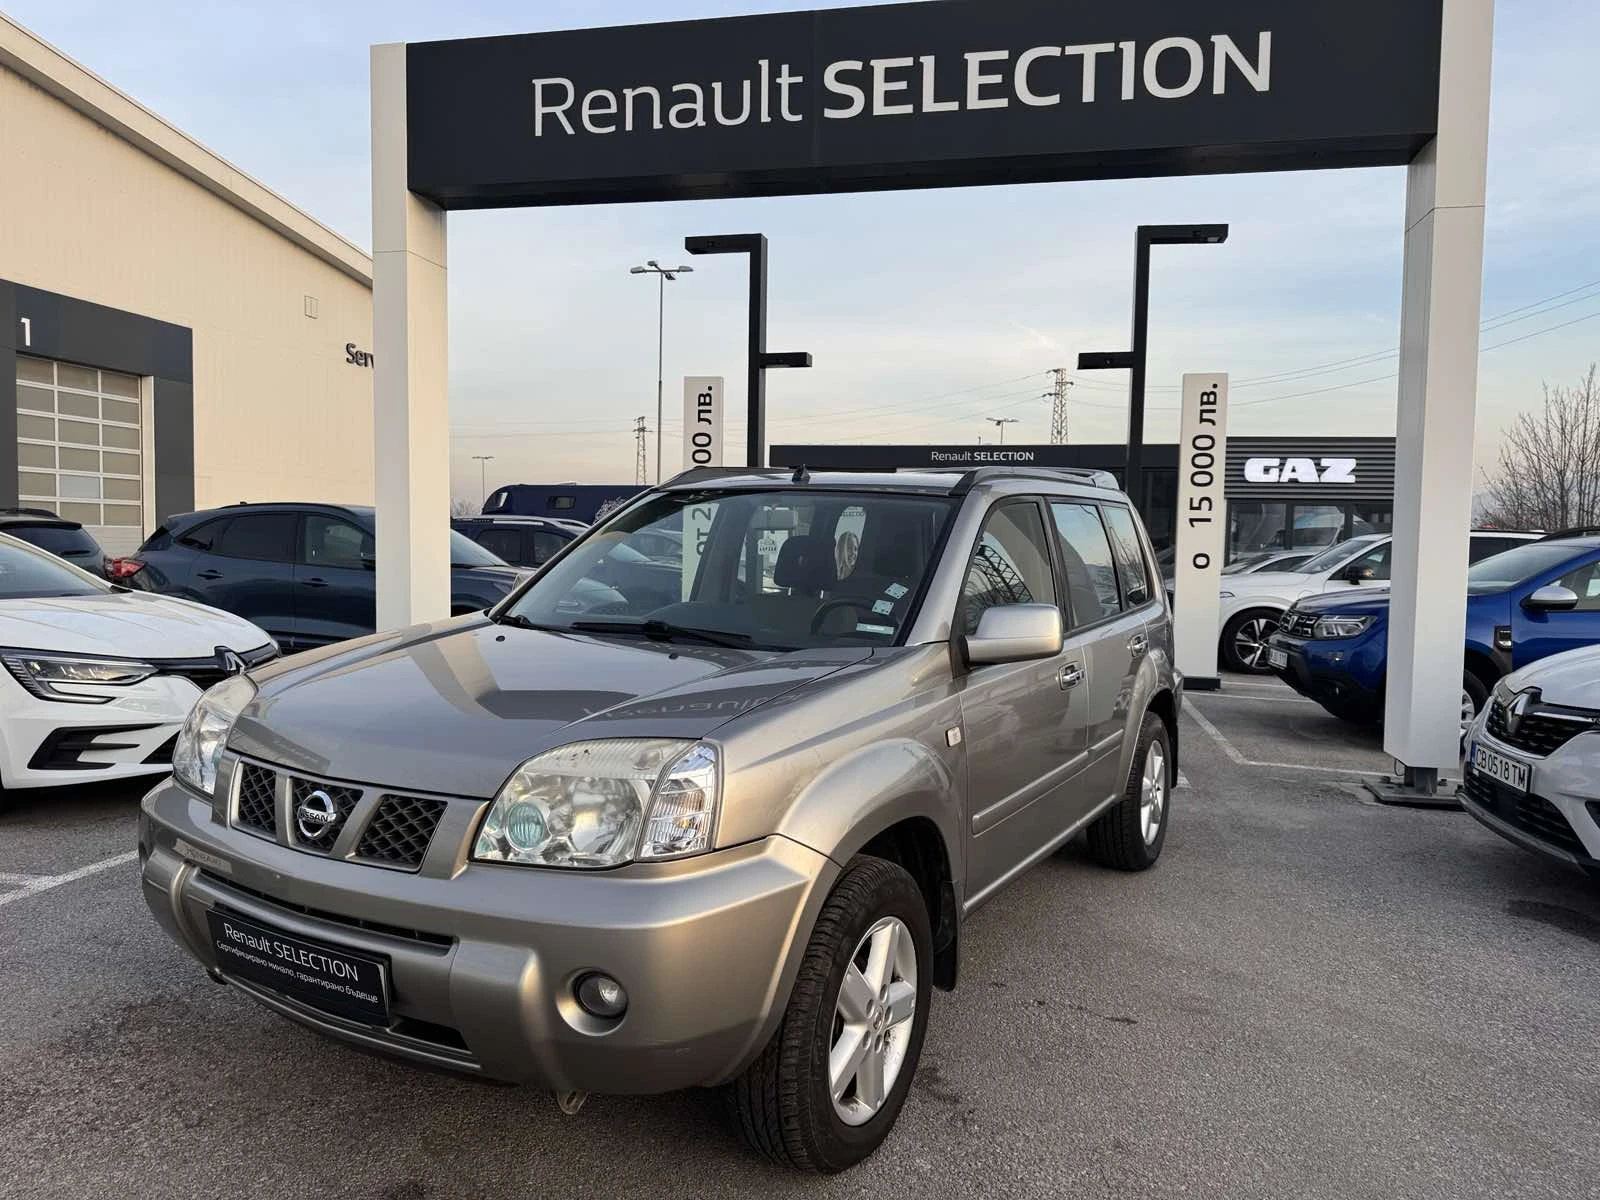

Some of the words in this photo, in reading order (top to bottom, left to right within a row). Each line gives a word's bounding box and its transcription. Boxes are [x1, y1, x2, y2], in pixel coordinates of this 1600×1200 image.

[532, 58, 804, 137] Renault
[822, 30, 1273, 121] SELECTION
[20, 316, 31, 347] 1
[697, 385, 713, 426] лв.
[1200, 383, 1219, 426] лв.
[691, 432, 713, 468] 00
[930, 451, 972, 462] Renault
[973, 451, 1035, 462] SELECTION
[1190, 434, 1216, 488] 000
[1243, 457, 1357, 483] GAZ
[1189, 497, 1212, 528] 15
[1488, 754, 1509, 780] 0518
[1511, 764, 1526, 788] TM
[224, 922, 272, 955] Renault
[273, 940, 359, 982] SELECTION
[345, 985, 379, 1004] бъдеще
